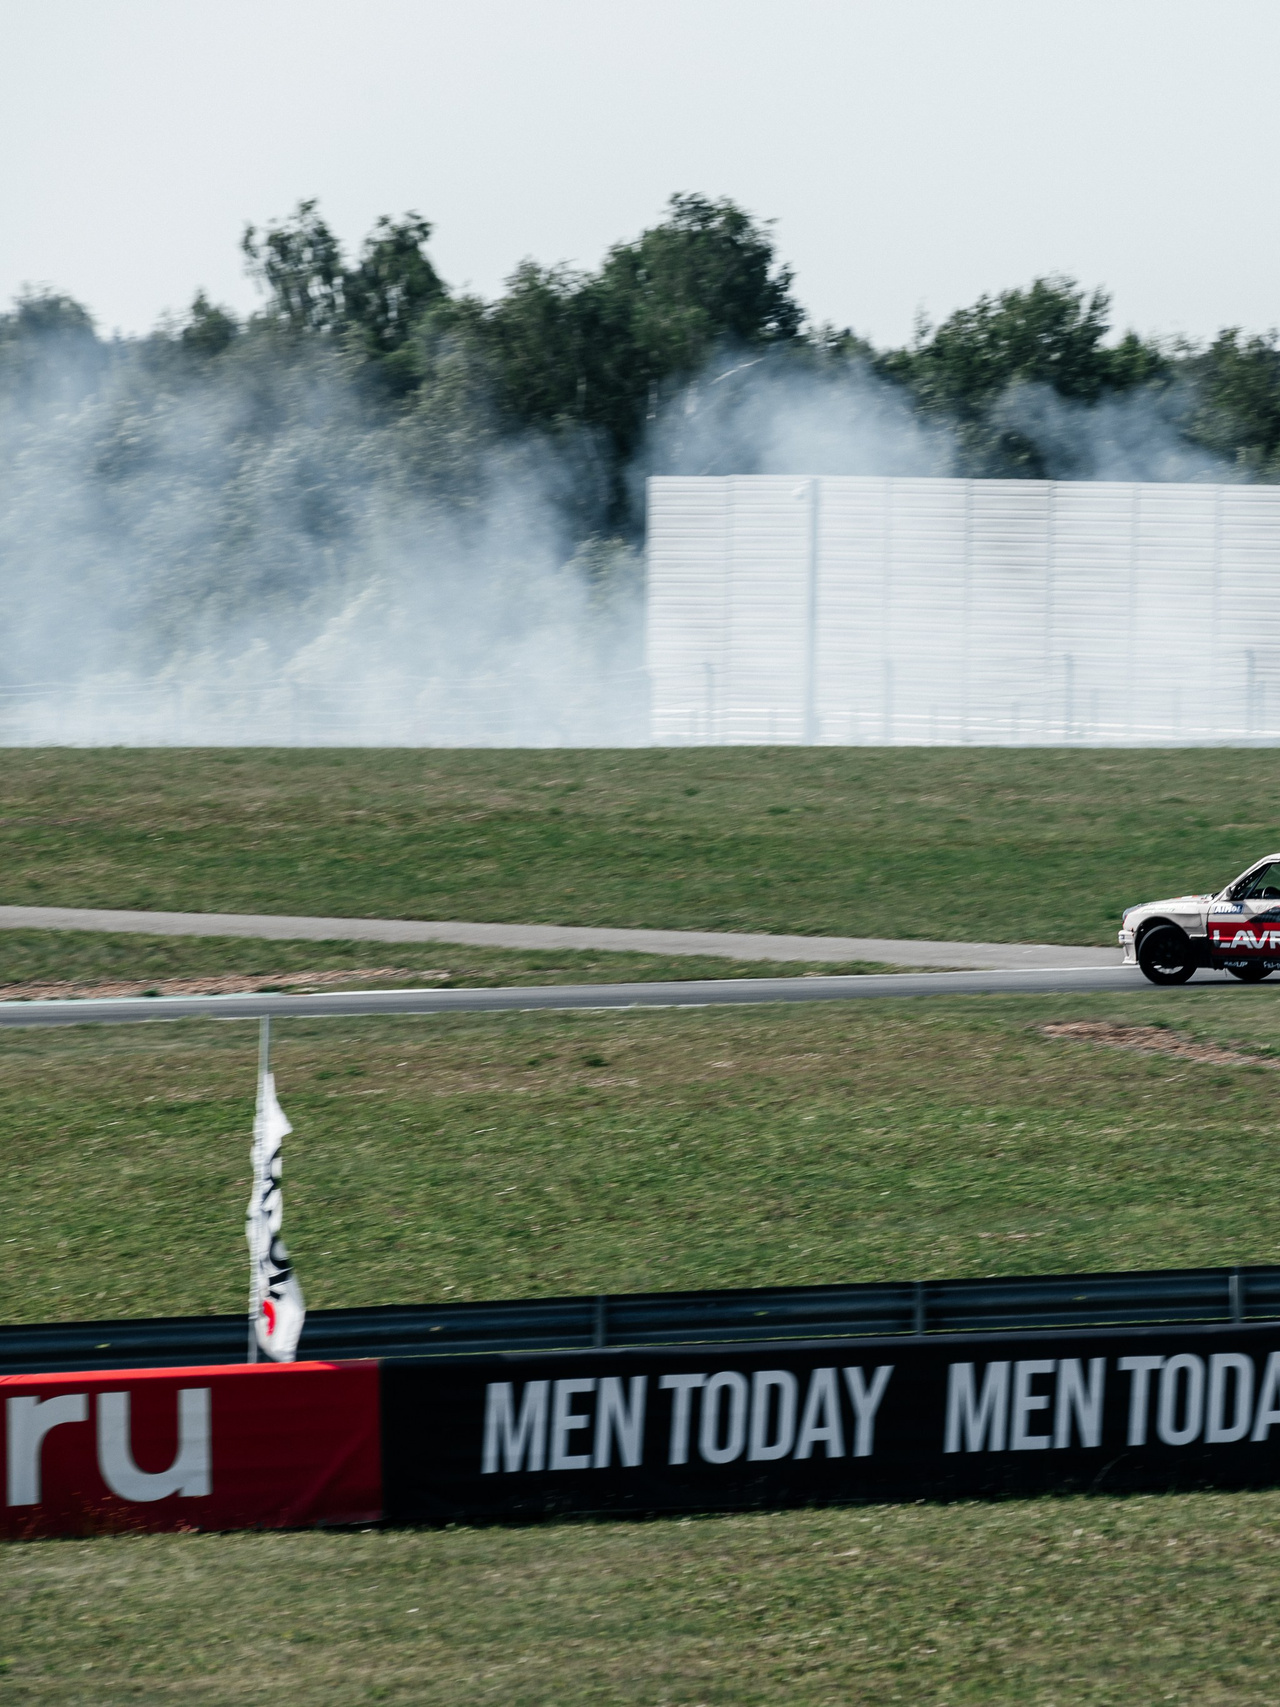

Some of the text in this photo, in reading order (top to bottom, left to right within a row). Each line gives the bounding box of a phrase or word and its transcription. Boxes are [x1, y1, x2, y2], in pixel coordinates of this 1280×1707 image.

[6, 1387, 212, 1507] ru
[481, 1365, 894, 1474] MEN TODAY
[944, 1357, 1106, 1453] MEN
